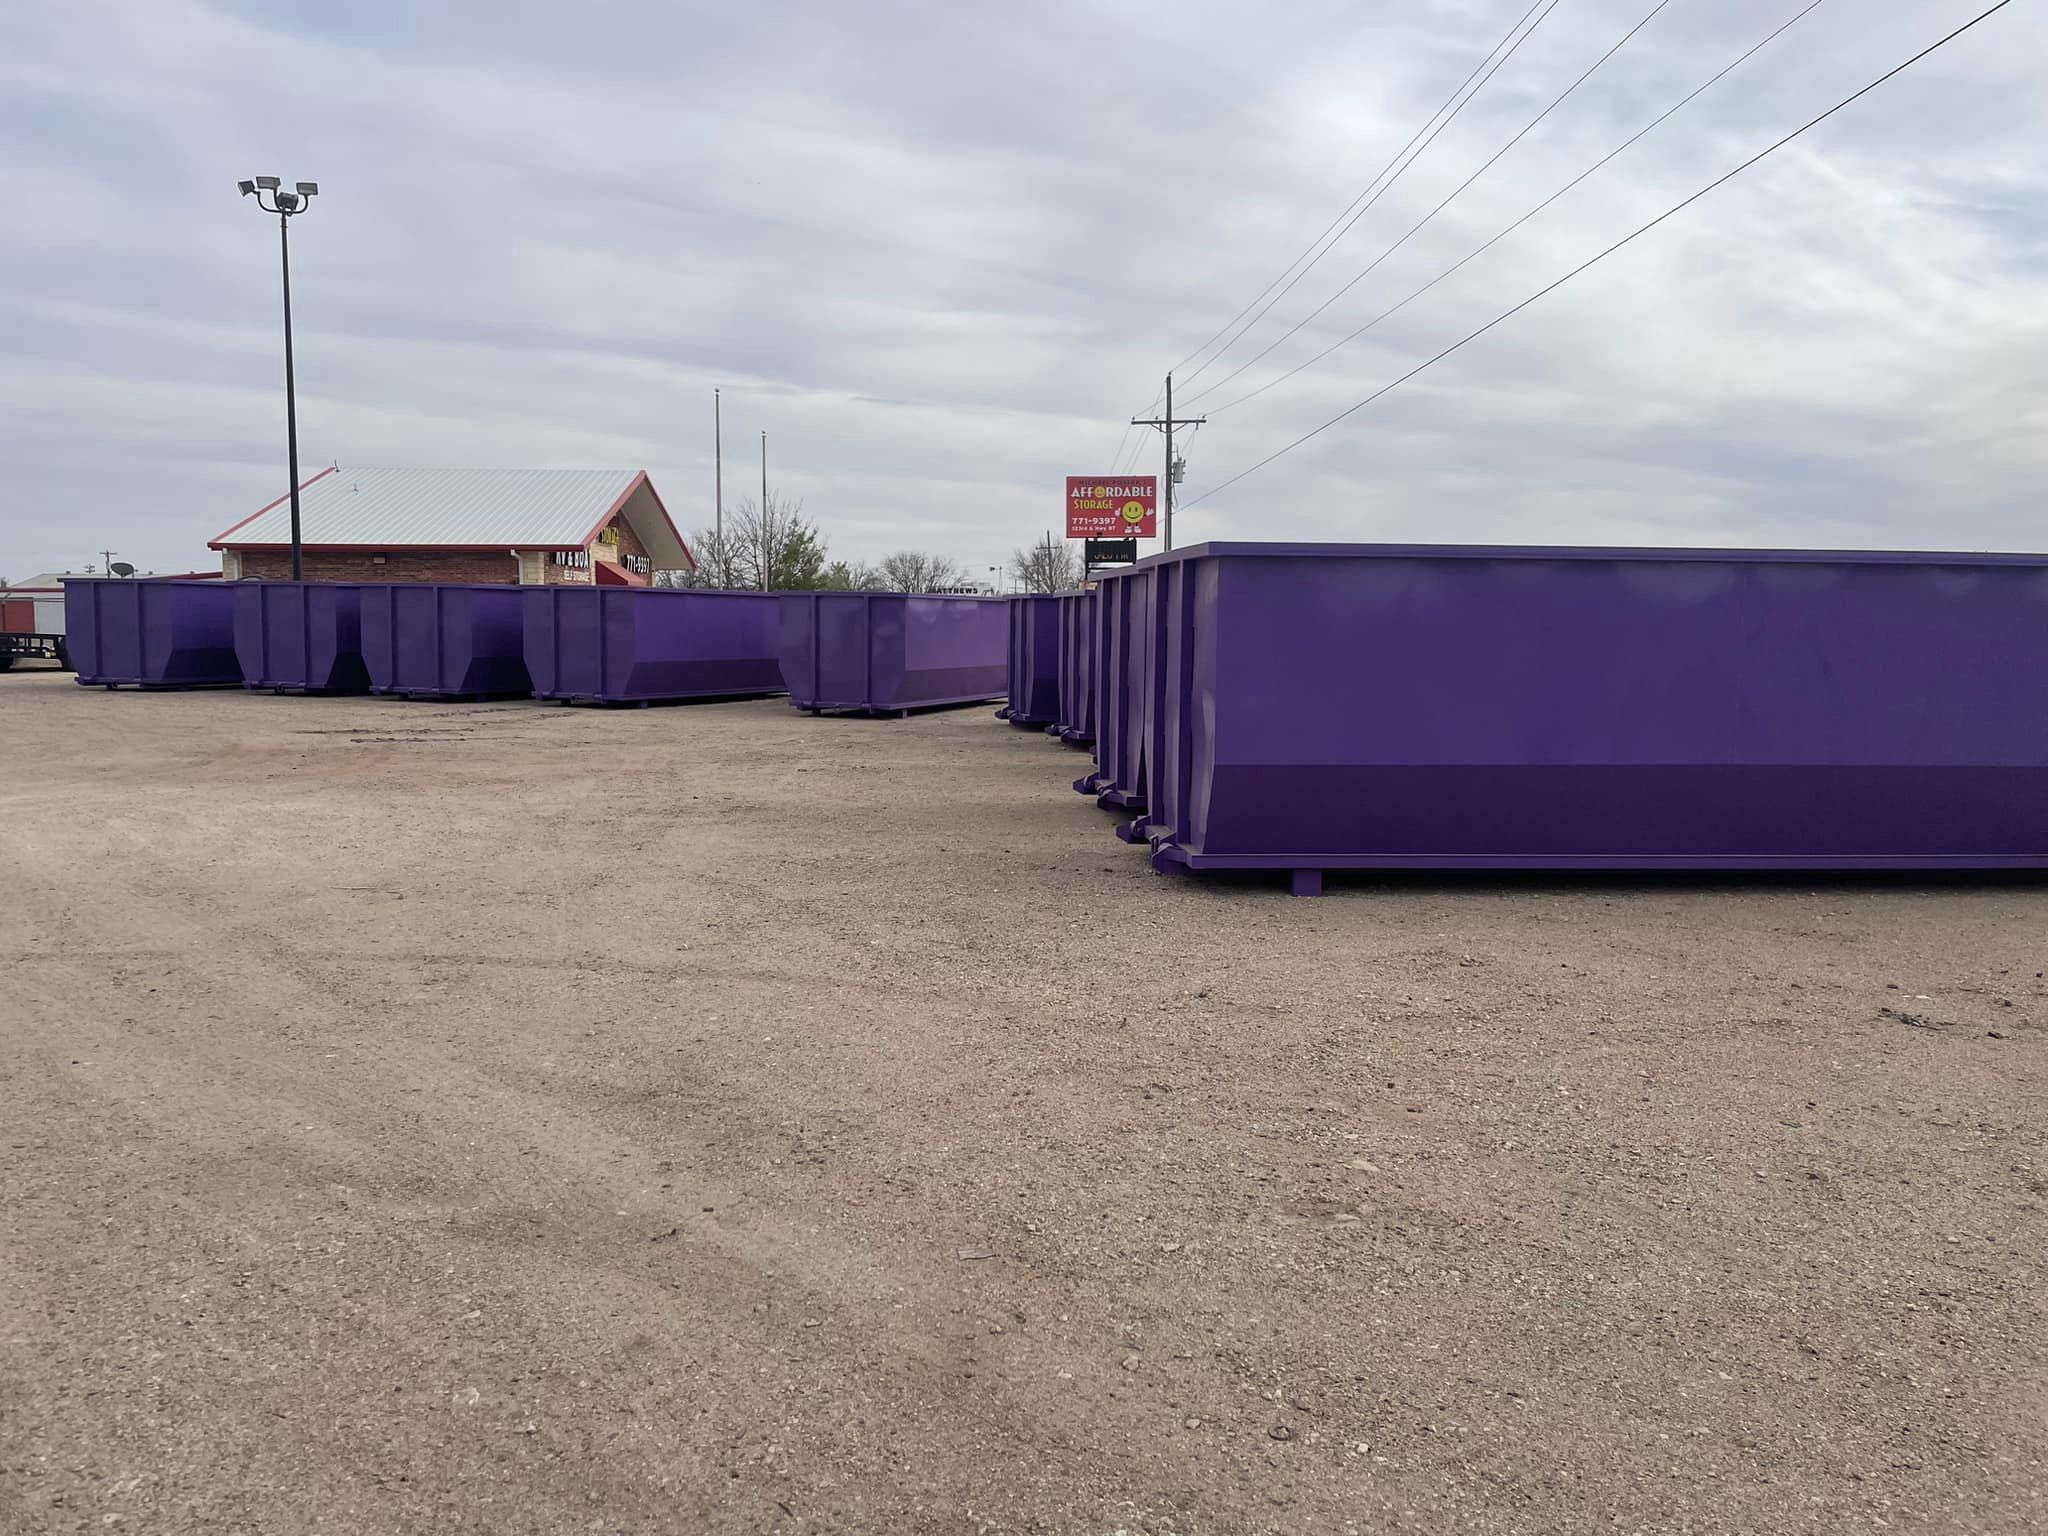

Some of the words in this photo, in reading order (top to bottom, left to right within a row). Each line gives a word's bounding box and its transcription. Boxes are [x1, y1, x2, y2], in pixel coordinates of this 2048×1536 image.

[1071, 486, 1153, 497] AFFORDABLE
[1074, 500, 1114, 509] STORAGE
[1072, 517, 1117, 525] 771-9397
